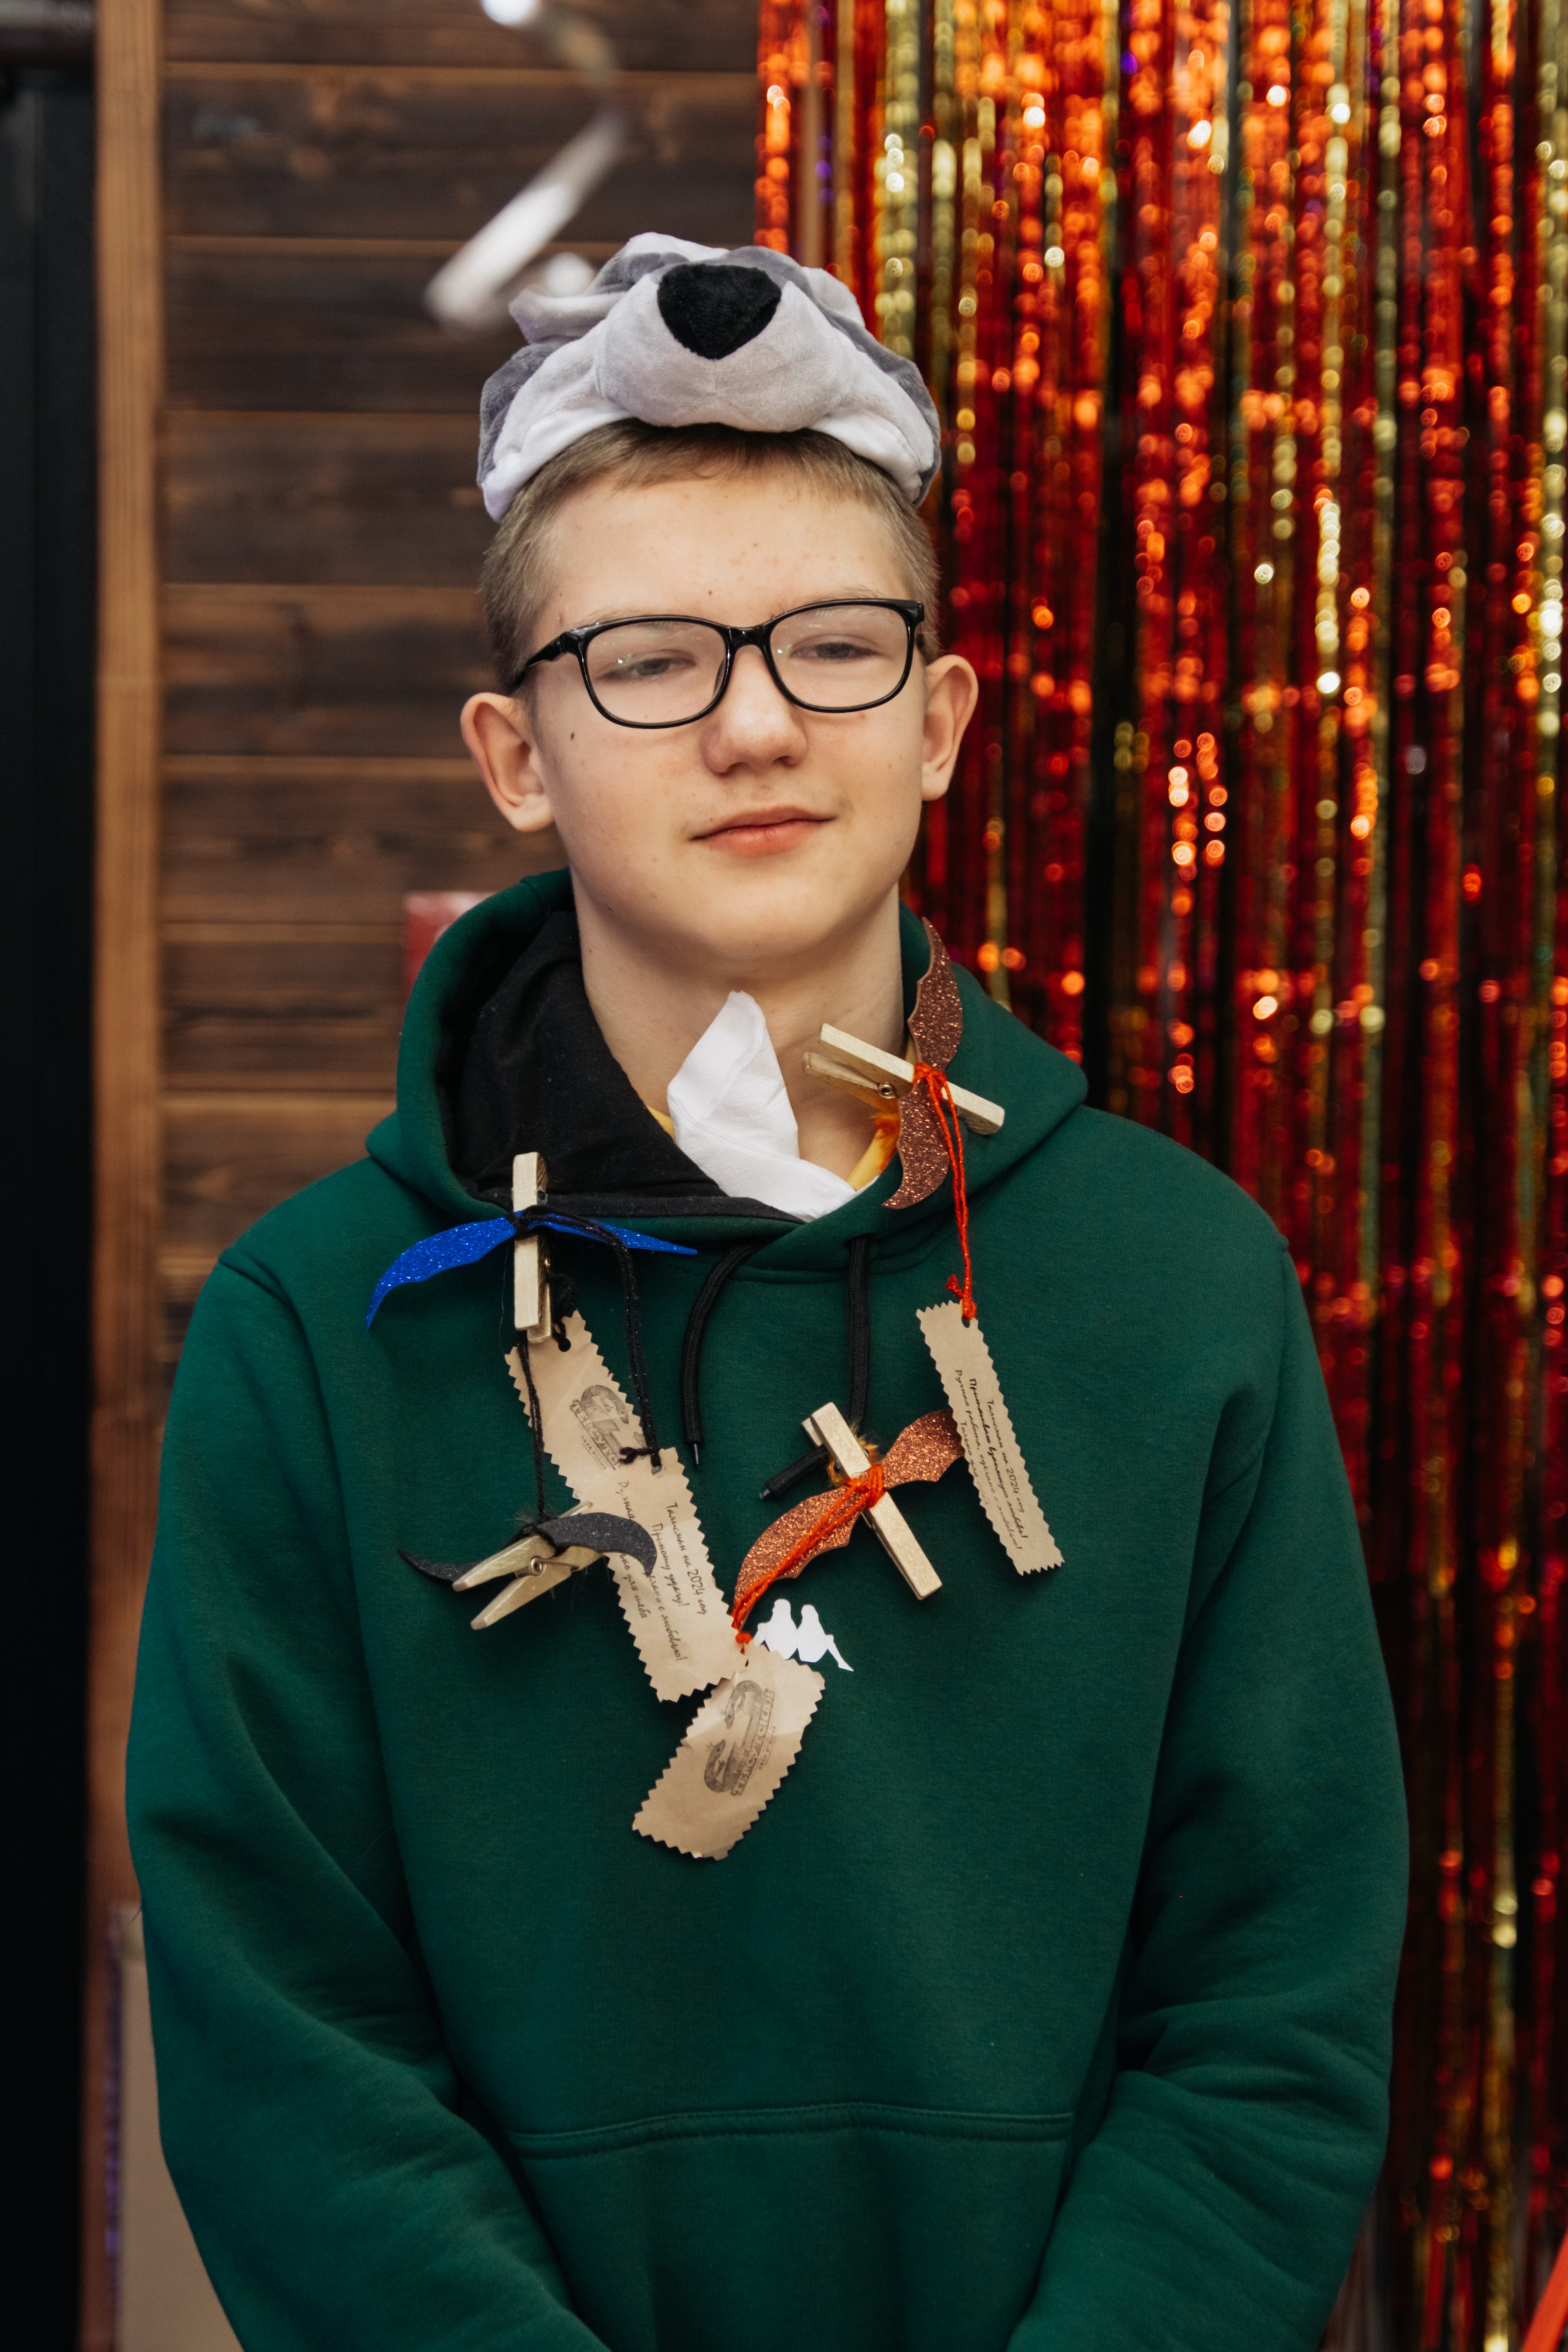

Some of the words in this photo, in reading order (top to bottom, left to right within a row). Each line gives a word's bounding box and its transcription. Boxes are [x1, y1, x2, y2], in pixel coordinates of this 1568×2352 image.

[987, 1400, 1003, 1448] Талисман
[1001, 1452, 1009, 1464] на
[1006, 1468, 1019, 1494] 2024
[666, 1502, 687, 1552] Талисман
[682, 1555, 692, 1568] на
[687, 1569, 706, 1596] 2024
[1006, 1501, 1028, 1538] любовь!
[652, 1523, 671, 1571] Приношу
[664, 1574, 691, 1607] удачу!
[661, 1615, 689, 1662] любовью!
[732, 1689, 774, 1795] ТЕРСУТСКАЯ
